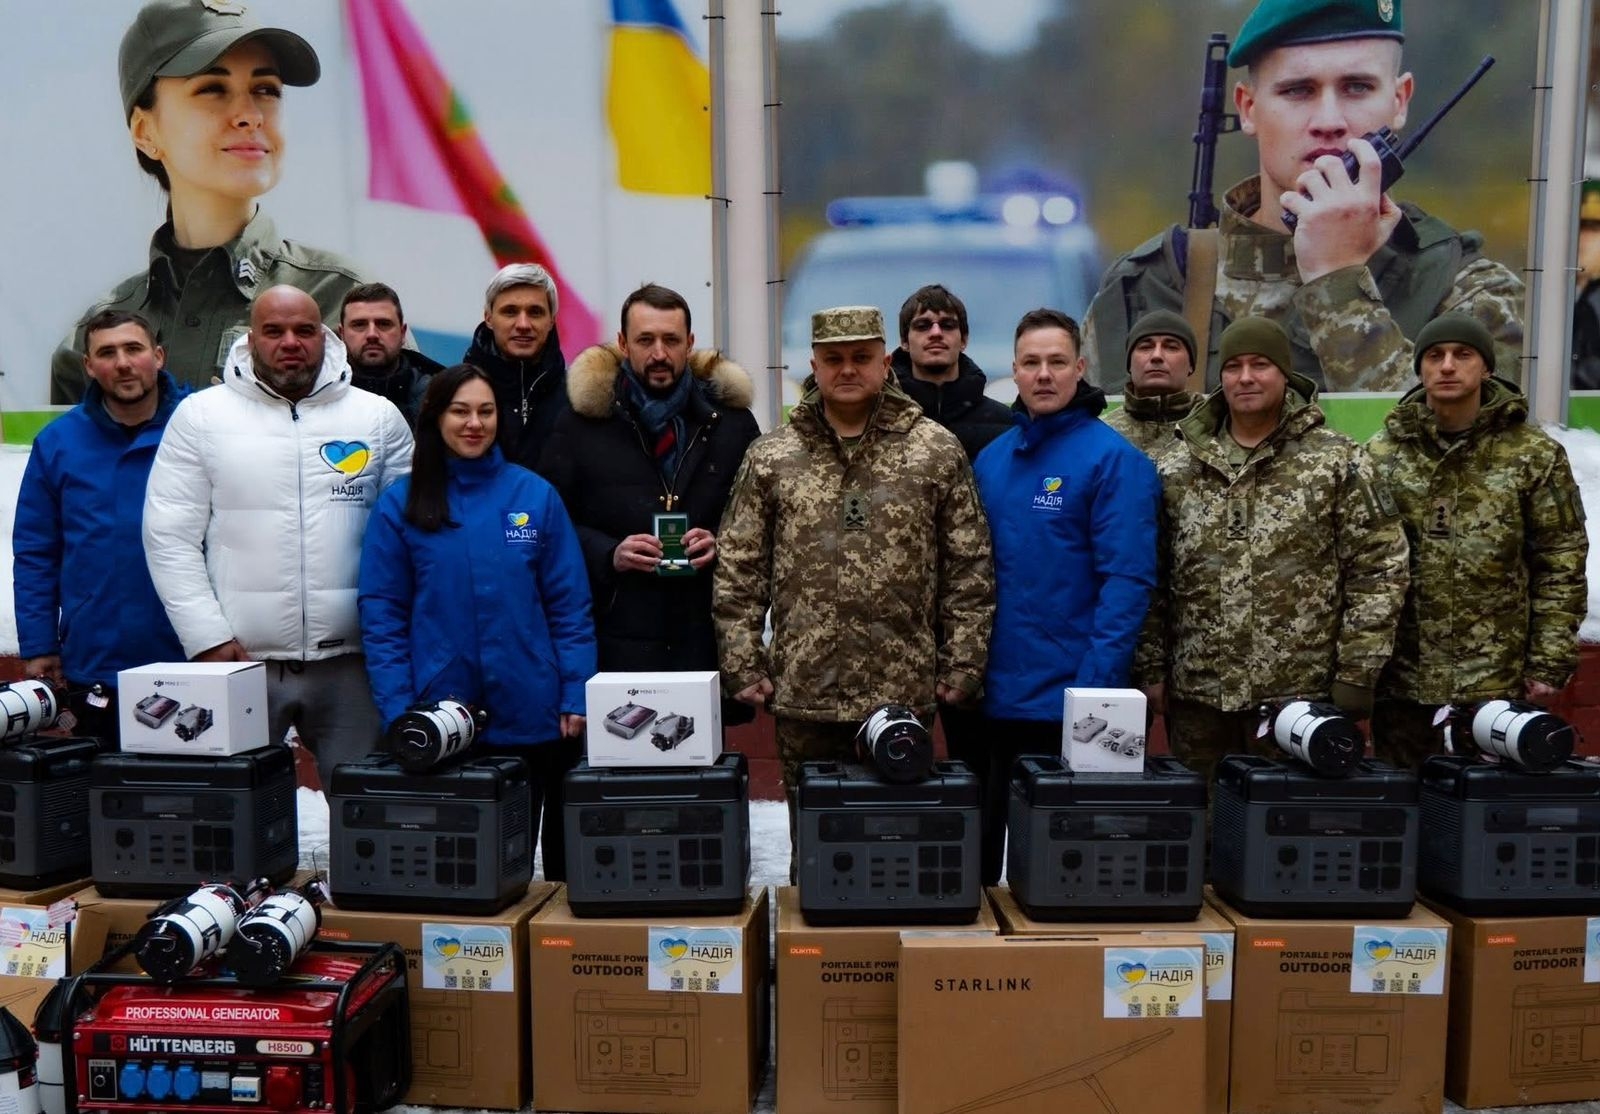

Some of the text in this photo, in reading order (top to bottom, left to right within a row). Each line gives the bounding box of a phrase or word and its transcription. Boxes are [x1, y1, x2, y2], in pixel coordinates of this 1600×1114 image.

[331, 485, 364, 497] НАДІЯ
[1033, 495, 1063, 507] НАДІЯ
[505, 529, 538, 539] НАДІЯ
[30, 930, 67, 944] НАДІЯ
[463, 945, 504, 958] НАДІЯ
[572, 953, 621, 962] PORTABLE
[691, 946, 733, 959] НАДІЯ
[1280, 951, 1329, 959] PORTABLE
[1395, 948, 1436, 960] НАДІЯ
[1513, 948, 1558, 957] PORTABLE
[572, 964, 644, 976] OUTDOOR
[821, 961, 872, 969] PORTABLE
[1280, 962, 1351, 973] OUTDOOR
[1513, 957, 1577, 971] OUTDOOR
[821, 972, 895, 983] OUTDOOR
[1150, 969, 1193, 982] НАДІЯ
[934, 978, 1031, 991] STARLINK
[126, 1006, 280, 1020] PROFESSIONAL GENERATOR
[129, 1035, 236, 1054] HÜTTENBERG
[267, 1042, 303, 1053] H8500
